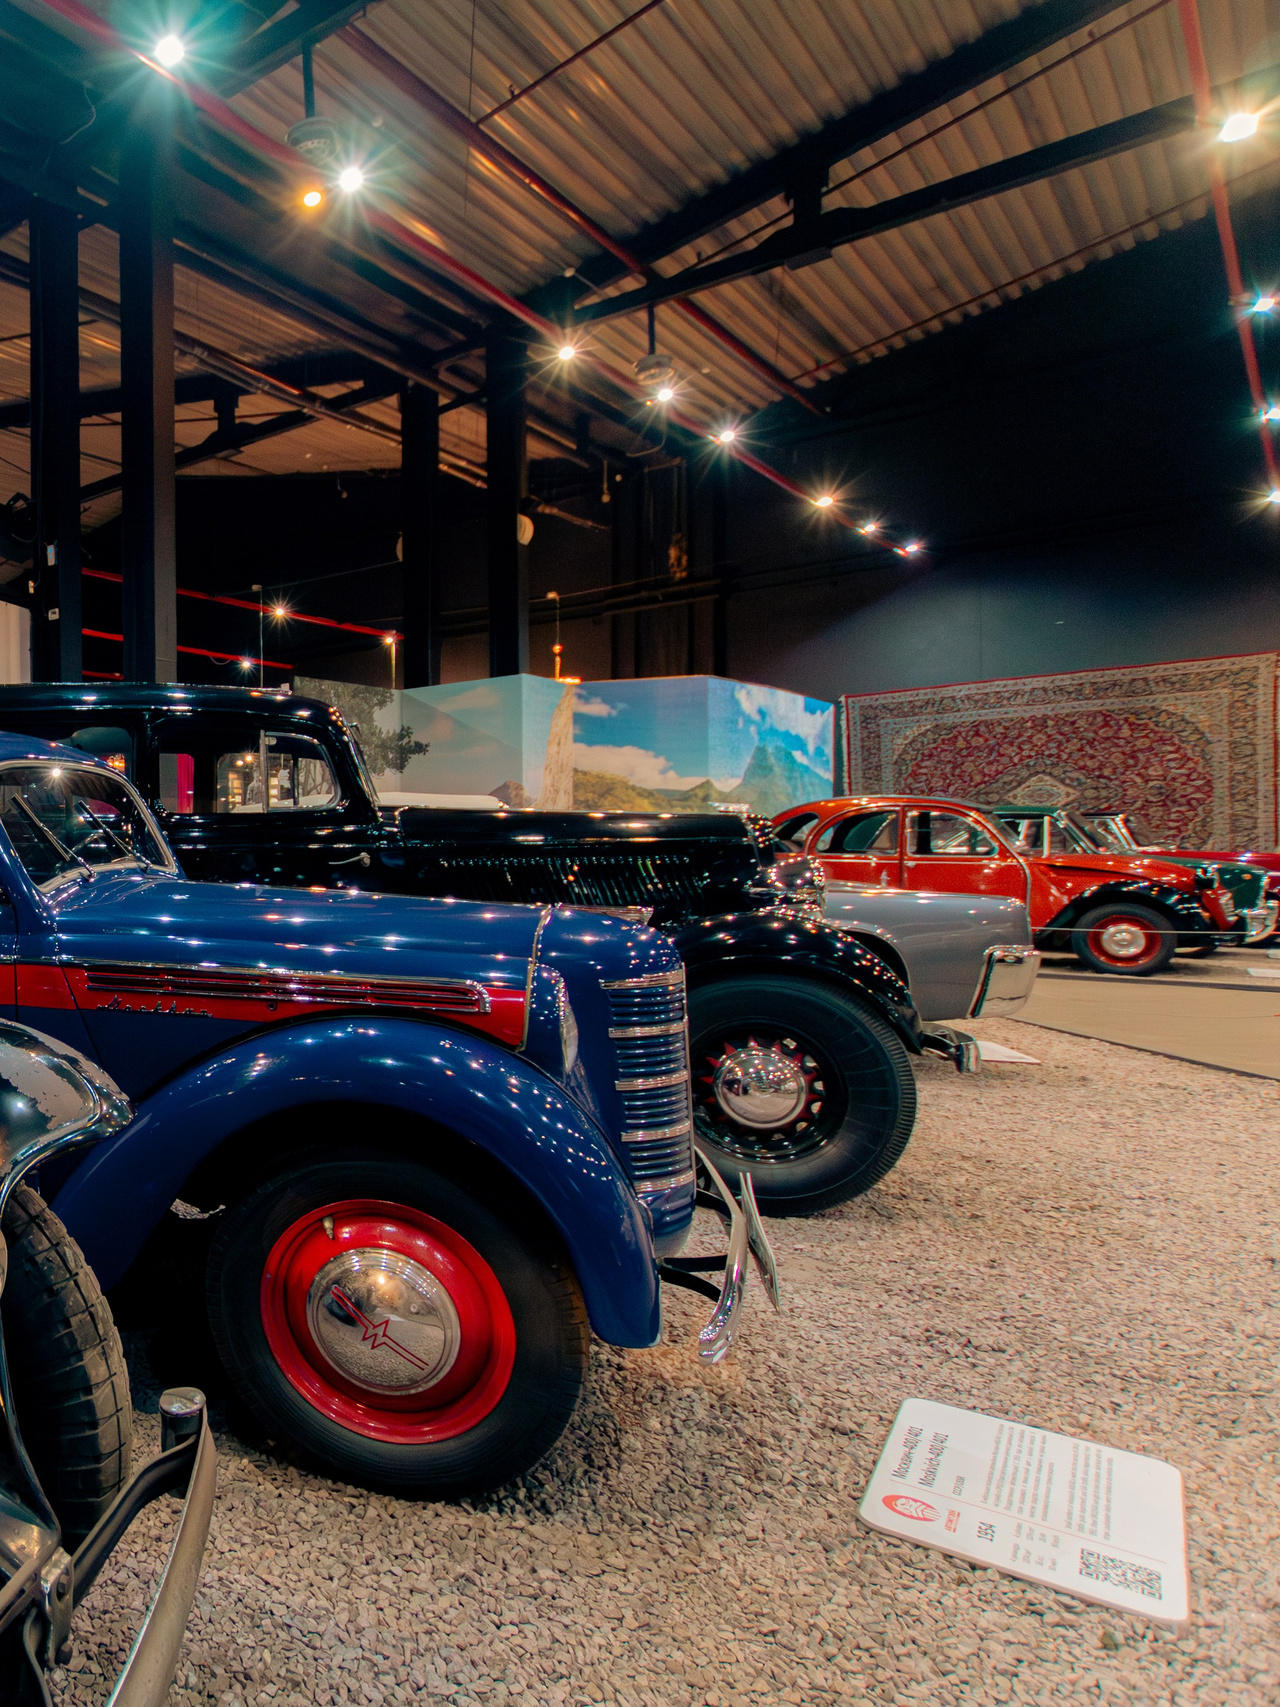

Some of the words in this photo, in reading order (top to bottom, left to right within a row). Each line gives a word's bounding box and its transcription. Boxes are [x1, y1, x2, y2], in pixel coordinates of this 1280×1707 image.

[890, 1425, 923, 1480] Москвич-400/401
[917, 1432, 949, 1488] Moskvich-400/401
[976, 1521, 996, 1543] 1954
